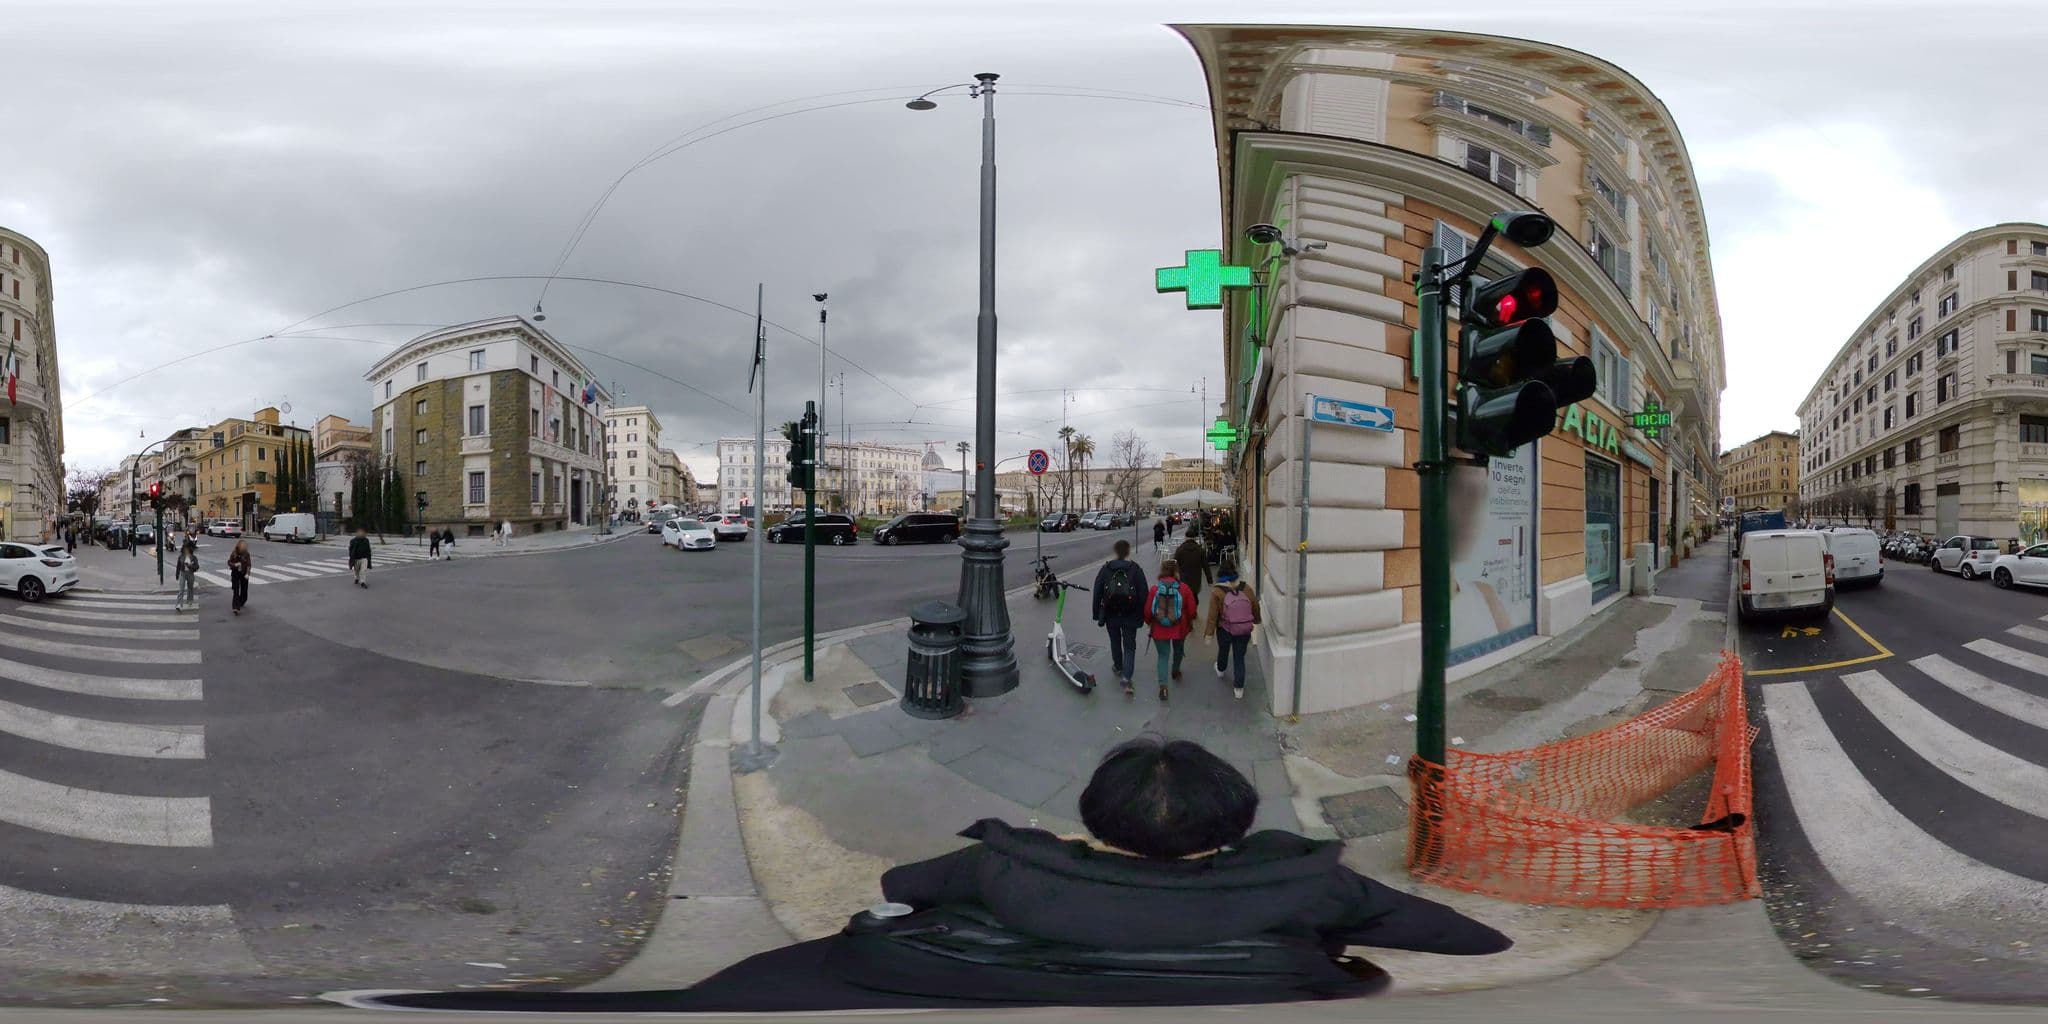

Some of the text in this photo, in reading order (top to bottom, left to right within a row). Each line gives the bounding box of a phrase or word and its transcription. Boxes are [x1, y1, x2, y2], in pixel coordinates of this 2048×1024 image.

[1557, 403, 1618, 455] ACIA
[1494, 459, 1524, 473] Inverte
[1492, 470, 1526, 486] 10 segni
